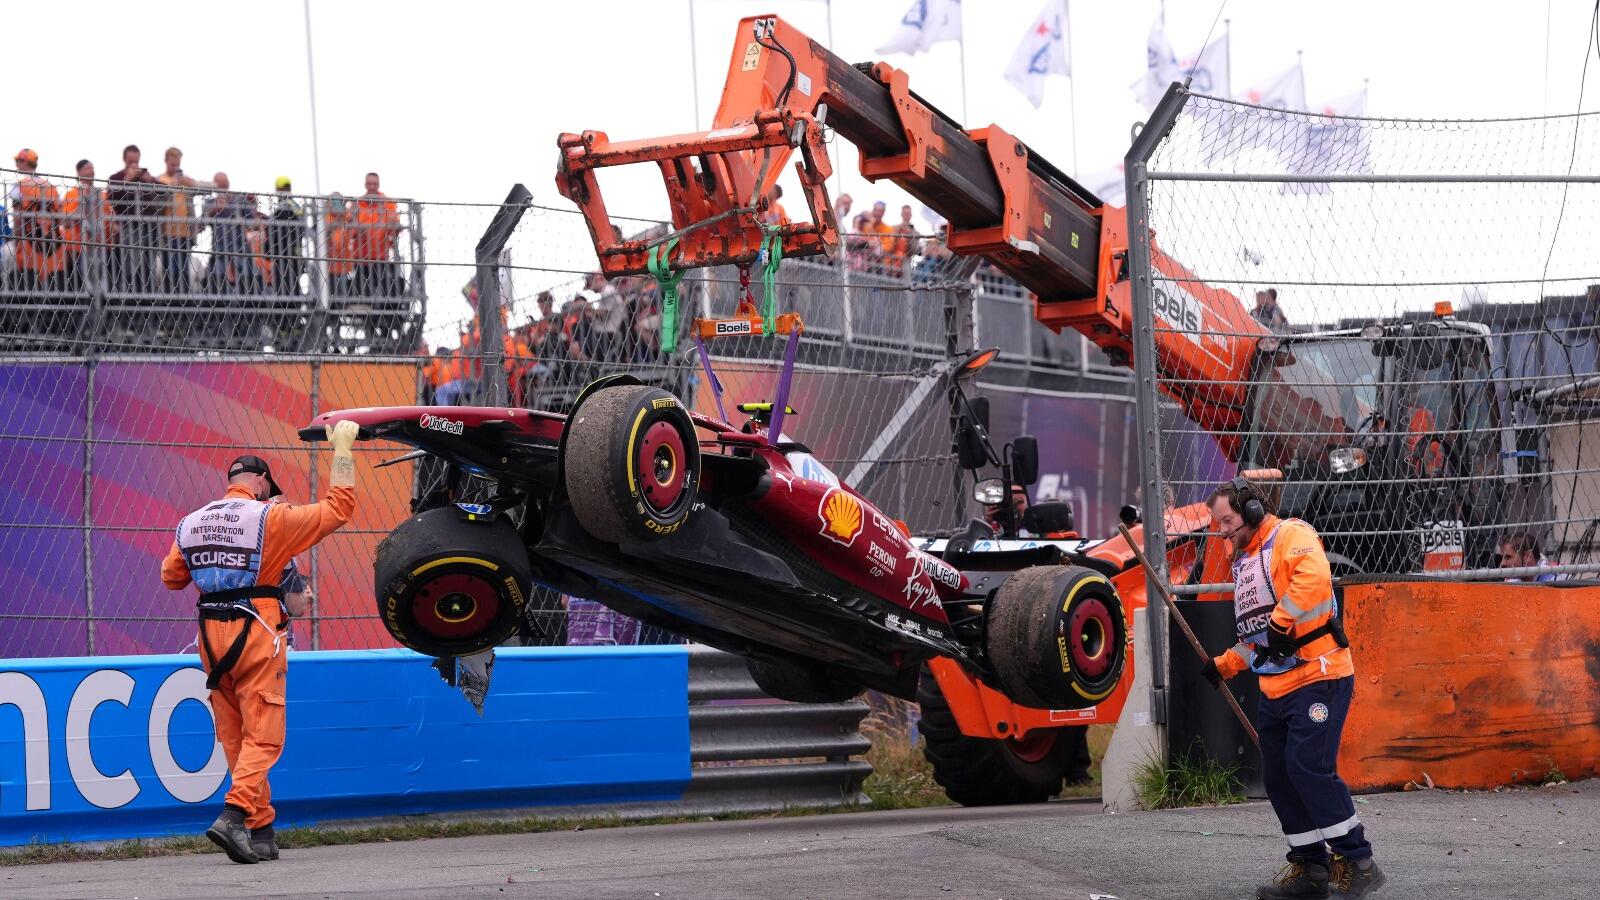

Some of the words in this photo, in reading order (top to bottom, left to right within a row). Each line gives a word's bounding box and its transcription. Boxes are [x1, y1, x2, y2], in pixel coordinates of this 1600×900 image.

[1154, 287, 1198, 332] oels
[717, 323, 750, 333] Boels
[652, 397, 676, 410] PIRELLI
[429, 416, 464, 435] UniCredit
[191, 525, 244, 535] INTERVENTION
[202, 534, 235, 544] MARSHAL
[644, 519, 681, 535] ZERO
[190, 551, 247, 567] COURSE
[869, 540, 897, 570] PERONI
[921, 555, 961, 588] UniCredit
[504, 576, 524, 607] PIRELLI
[387, 596, 407, 642] ZERO
[1236, 612, 1271, 637] OURSE
[1057, 636, 1071, 673] PIRELLI
[0, 667, 229, 811] nco
